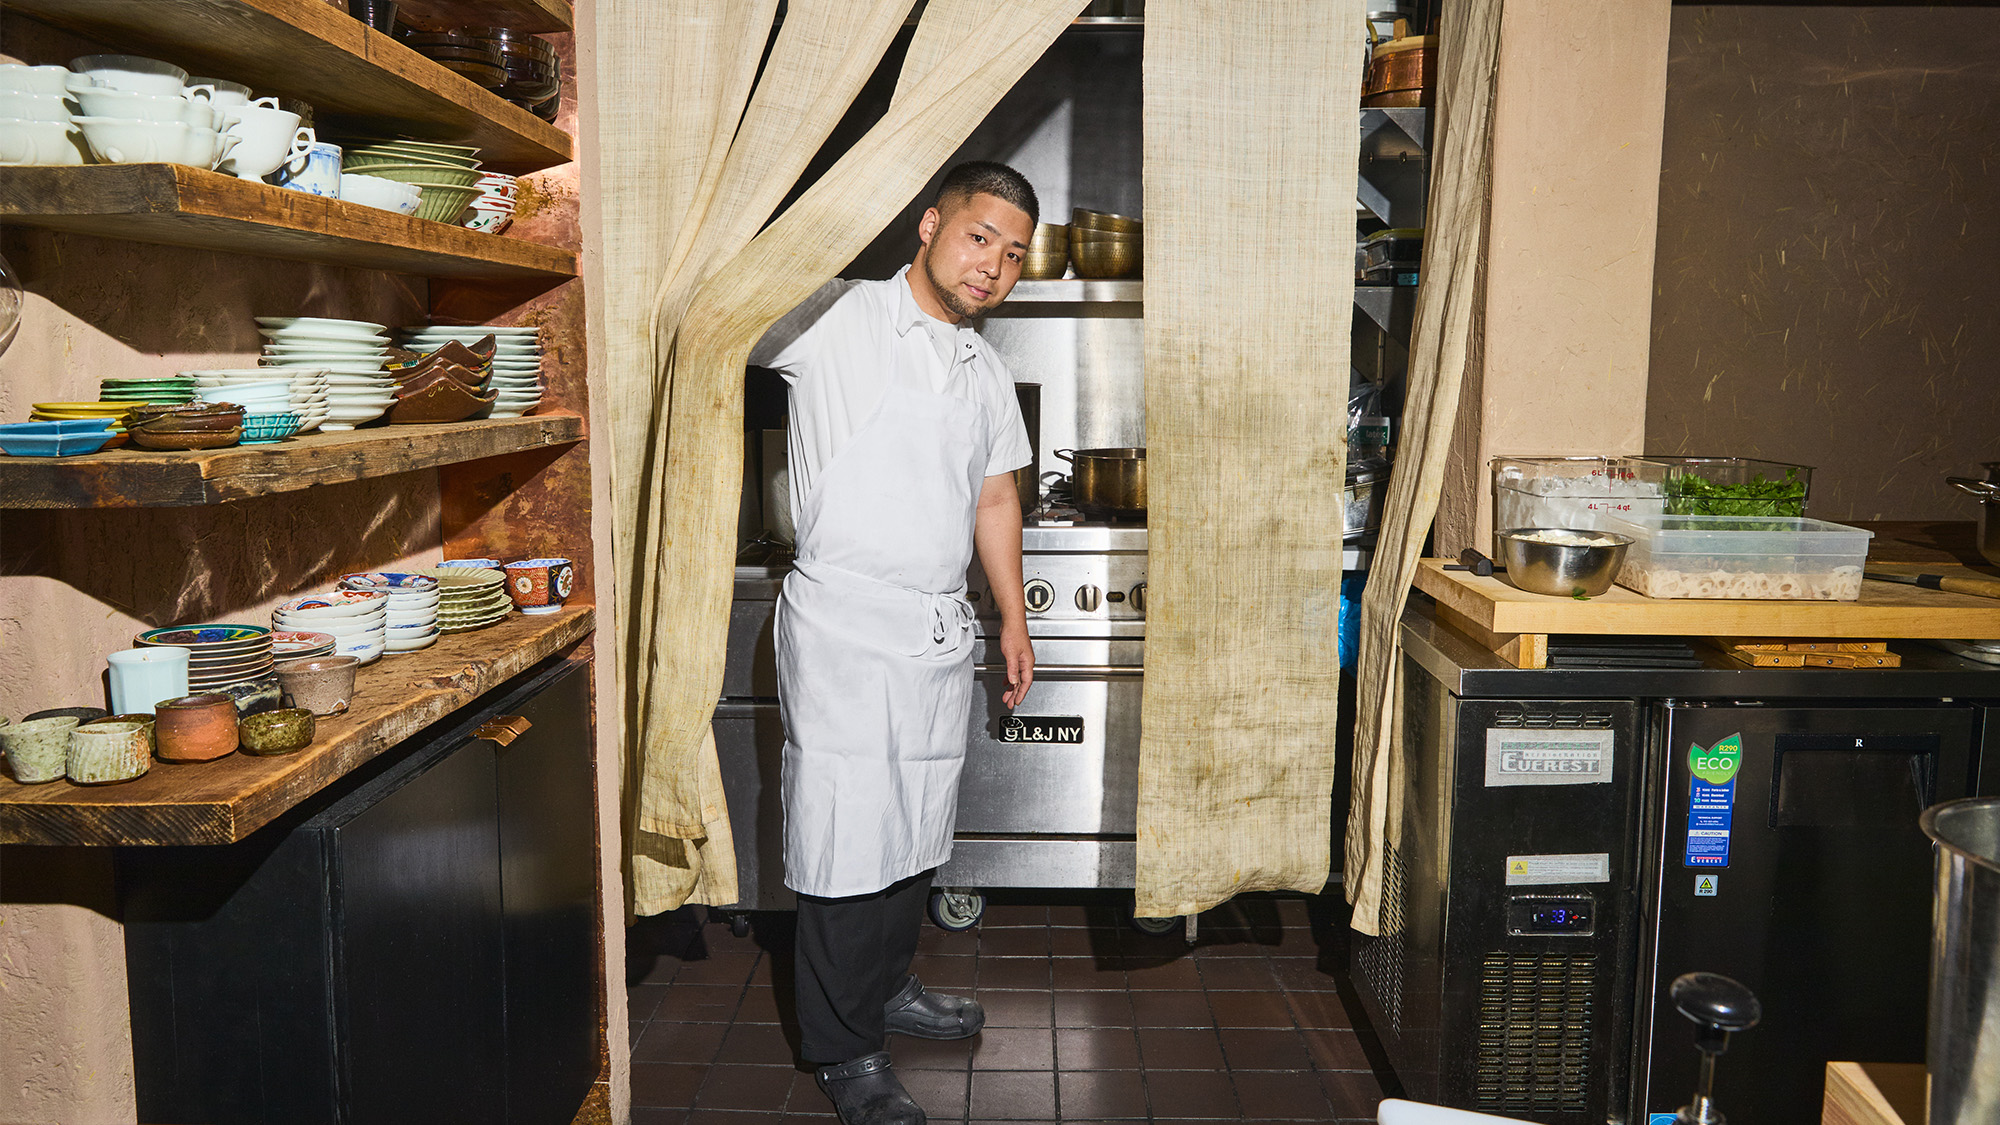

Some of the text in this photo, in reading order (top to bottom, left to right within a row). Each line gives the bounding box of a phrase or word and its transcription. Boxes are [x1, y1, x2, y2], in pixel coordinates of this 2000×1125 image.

[1023, 726, 1053, 741] L&J
[1057, 727, 1081, 741] NY
[1855, 738, 1863, 747] R
[1697, 757, 1733, 770] ECO
